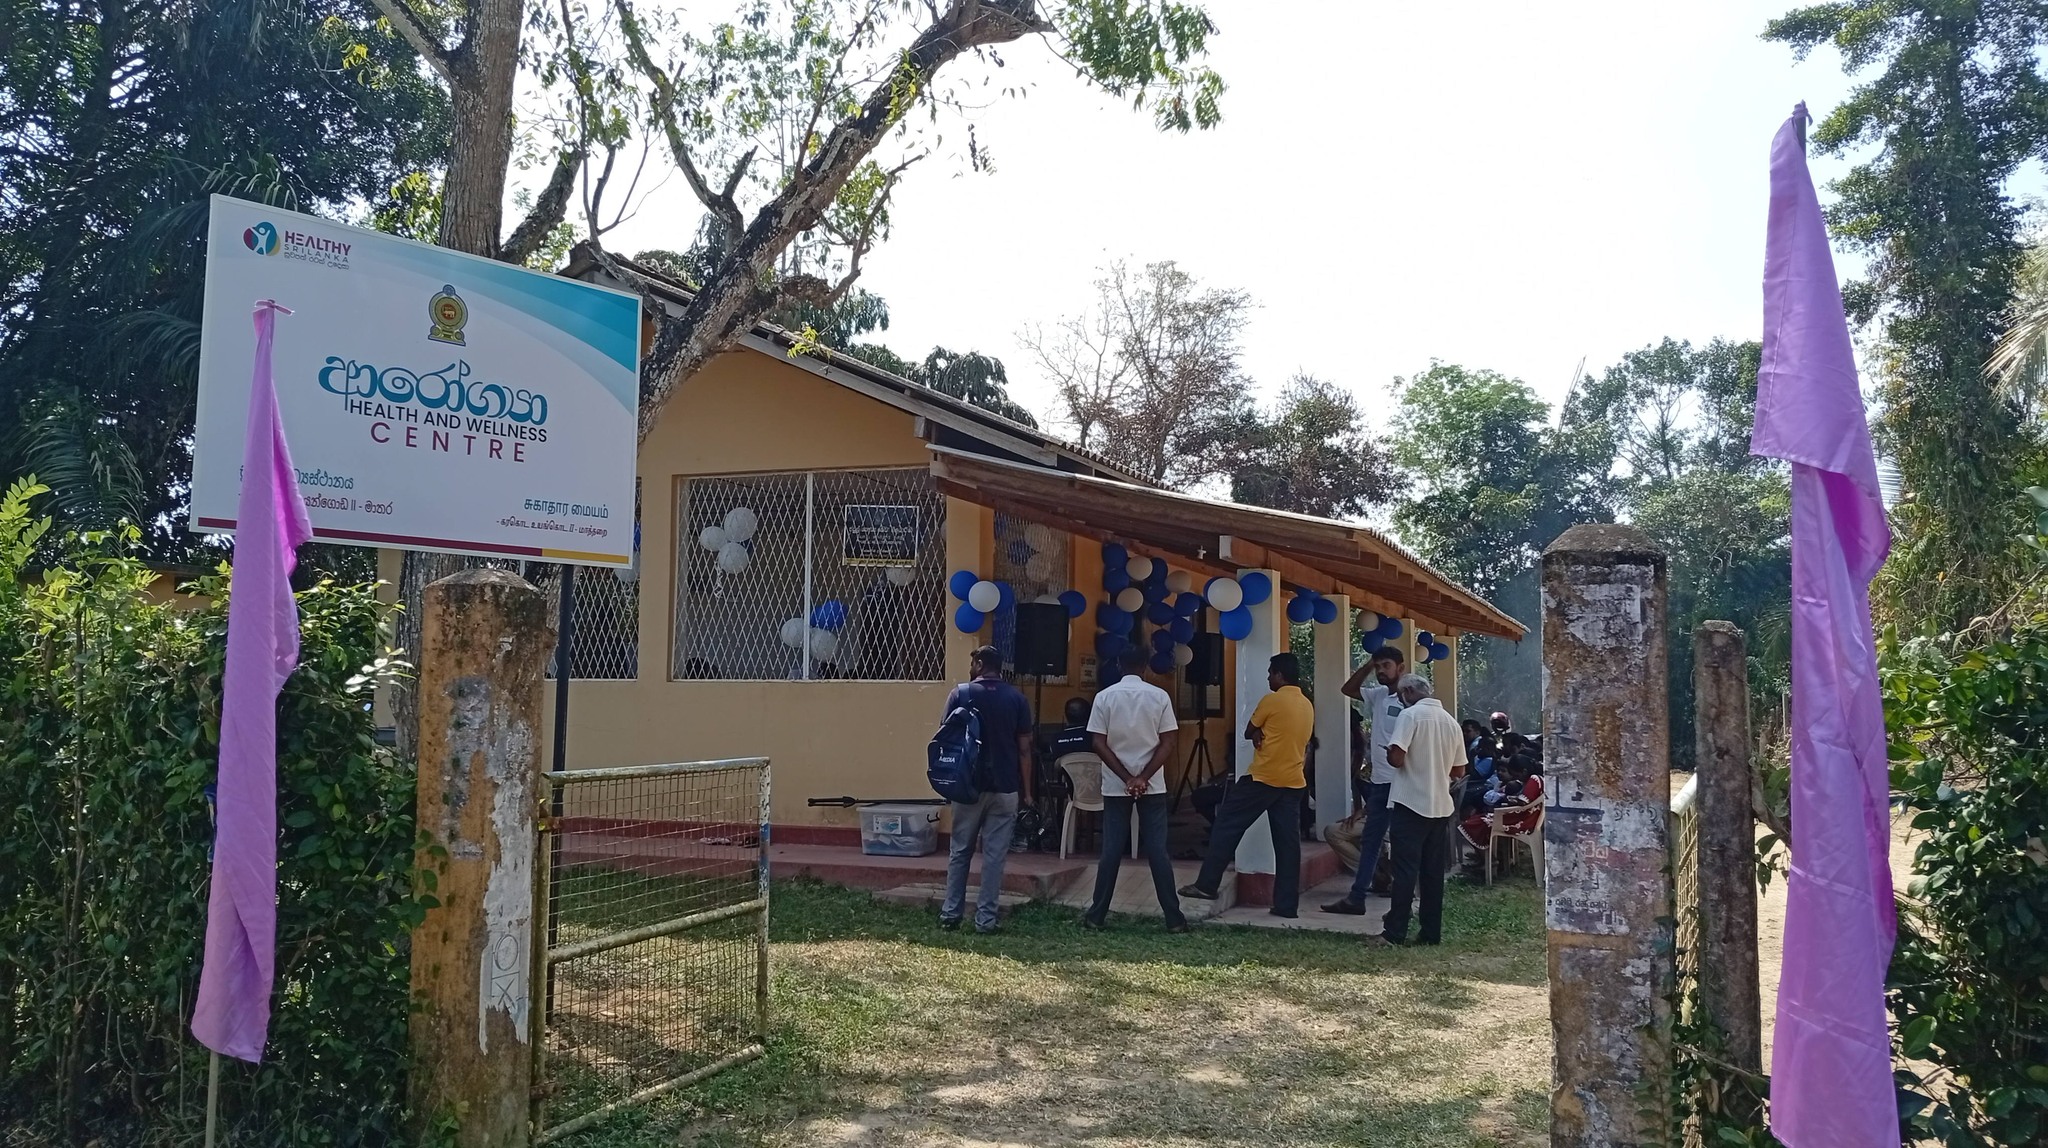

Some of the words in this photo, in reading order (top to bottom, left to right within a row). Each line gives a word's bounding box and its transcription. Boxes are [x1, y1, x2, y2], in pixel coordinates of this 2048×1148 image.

[285, 230, 351, 256] HEALTHY
[349, 399, 418, 423] HEALTH
[423, 411, 461, 429] AND
[466, 417, 548, 443] WELLNESS
[370, 421, 526, 463] CENTRE
[364, 500, 394, 515] මාතර
[524, 498, 569, 517] சுகாதார
[571, 503, 609, 519] மையம்
[578, 524, 608, 538] மாத்தறை
